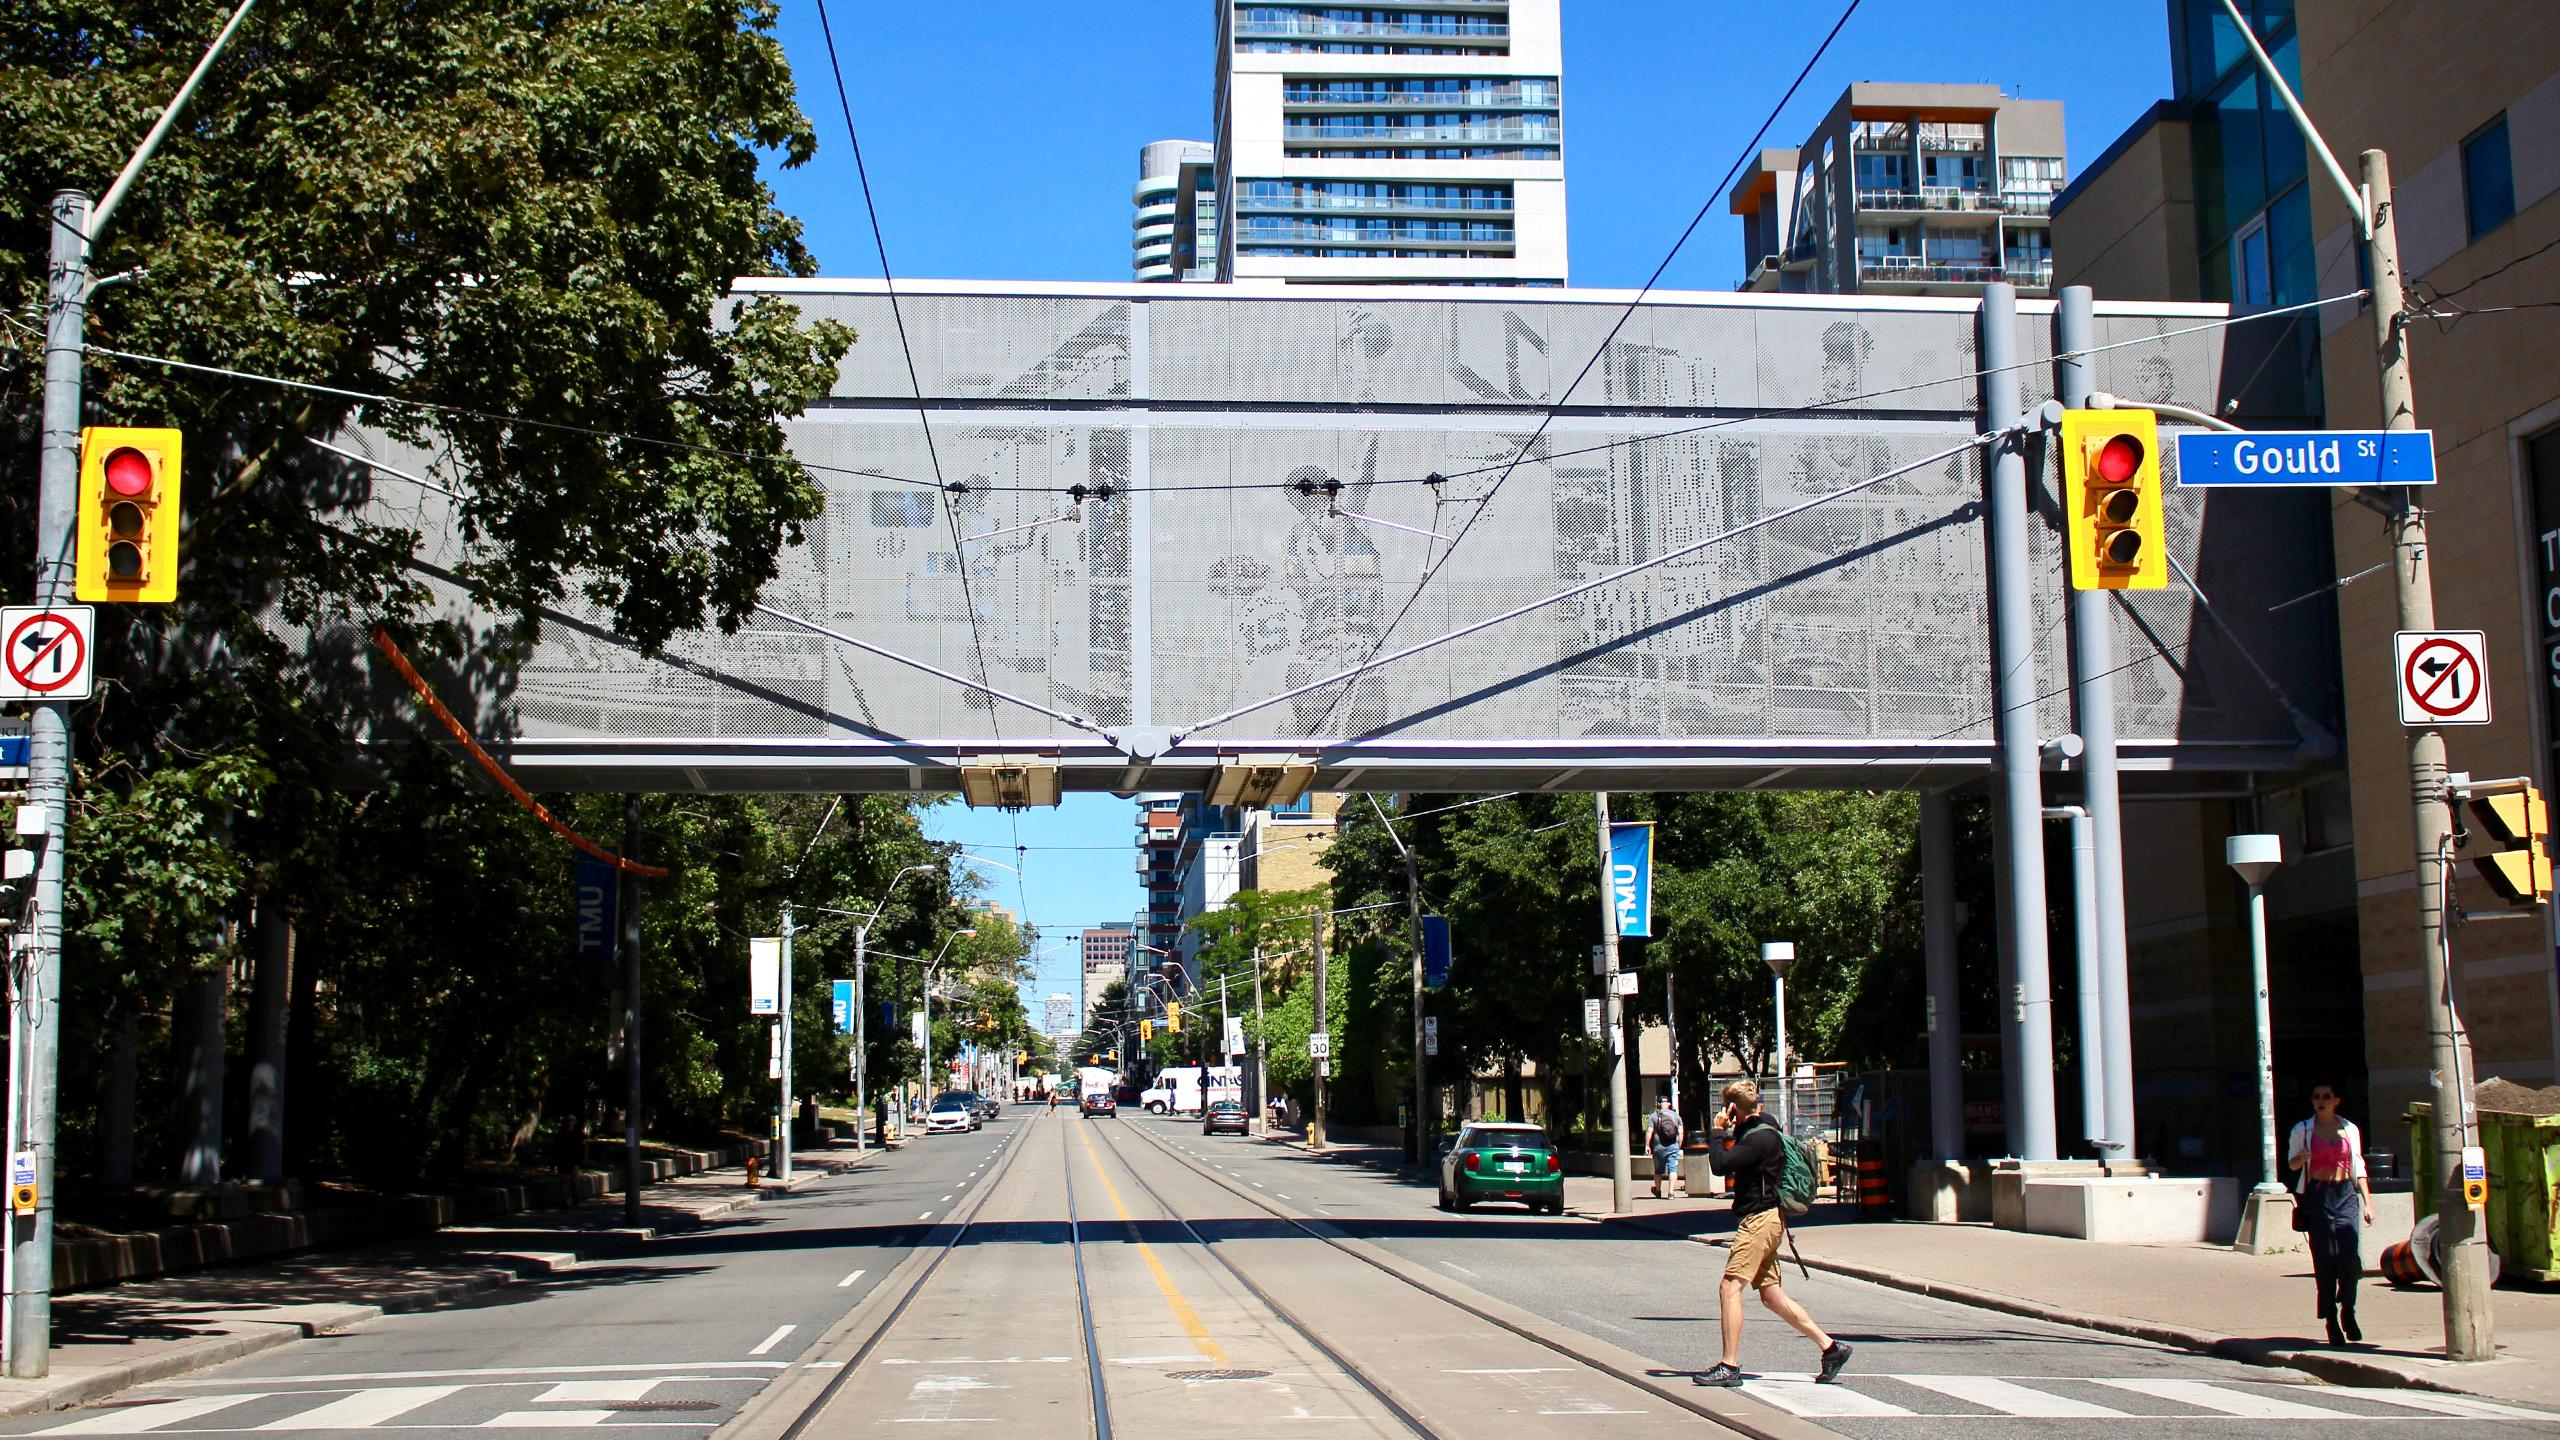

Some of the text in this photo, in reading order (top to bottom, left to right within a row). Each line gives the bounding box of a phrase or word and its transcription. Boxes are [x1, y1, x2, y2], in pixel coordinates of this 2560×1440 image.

[2234, 439, 2377, 474] Gould St
[579, 886, 604, 953] TMU
[1613, 864, 1638, 931] TMU
[1312, 1043, 1328, 1054] 30
